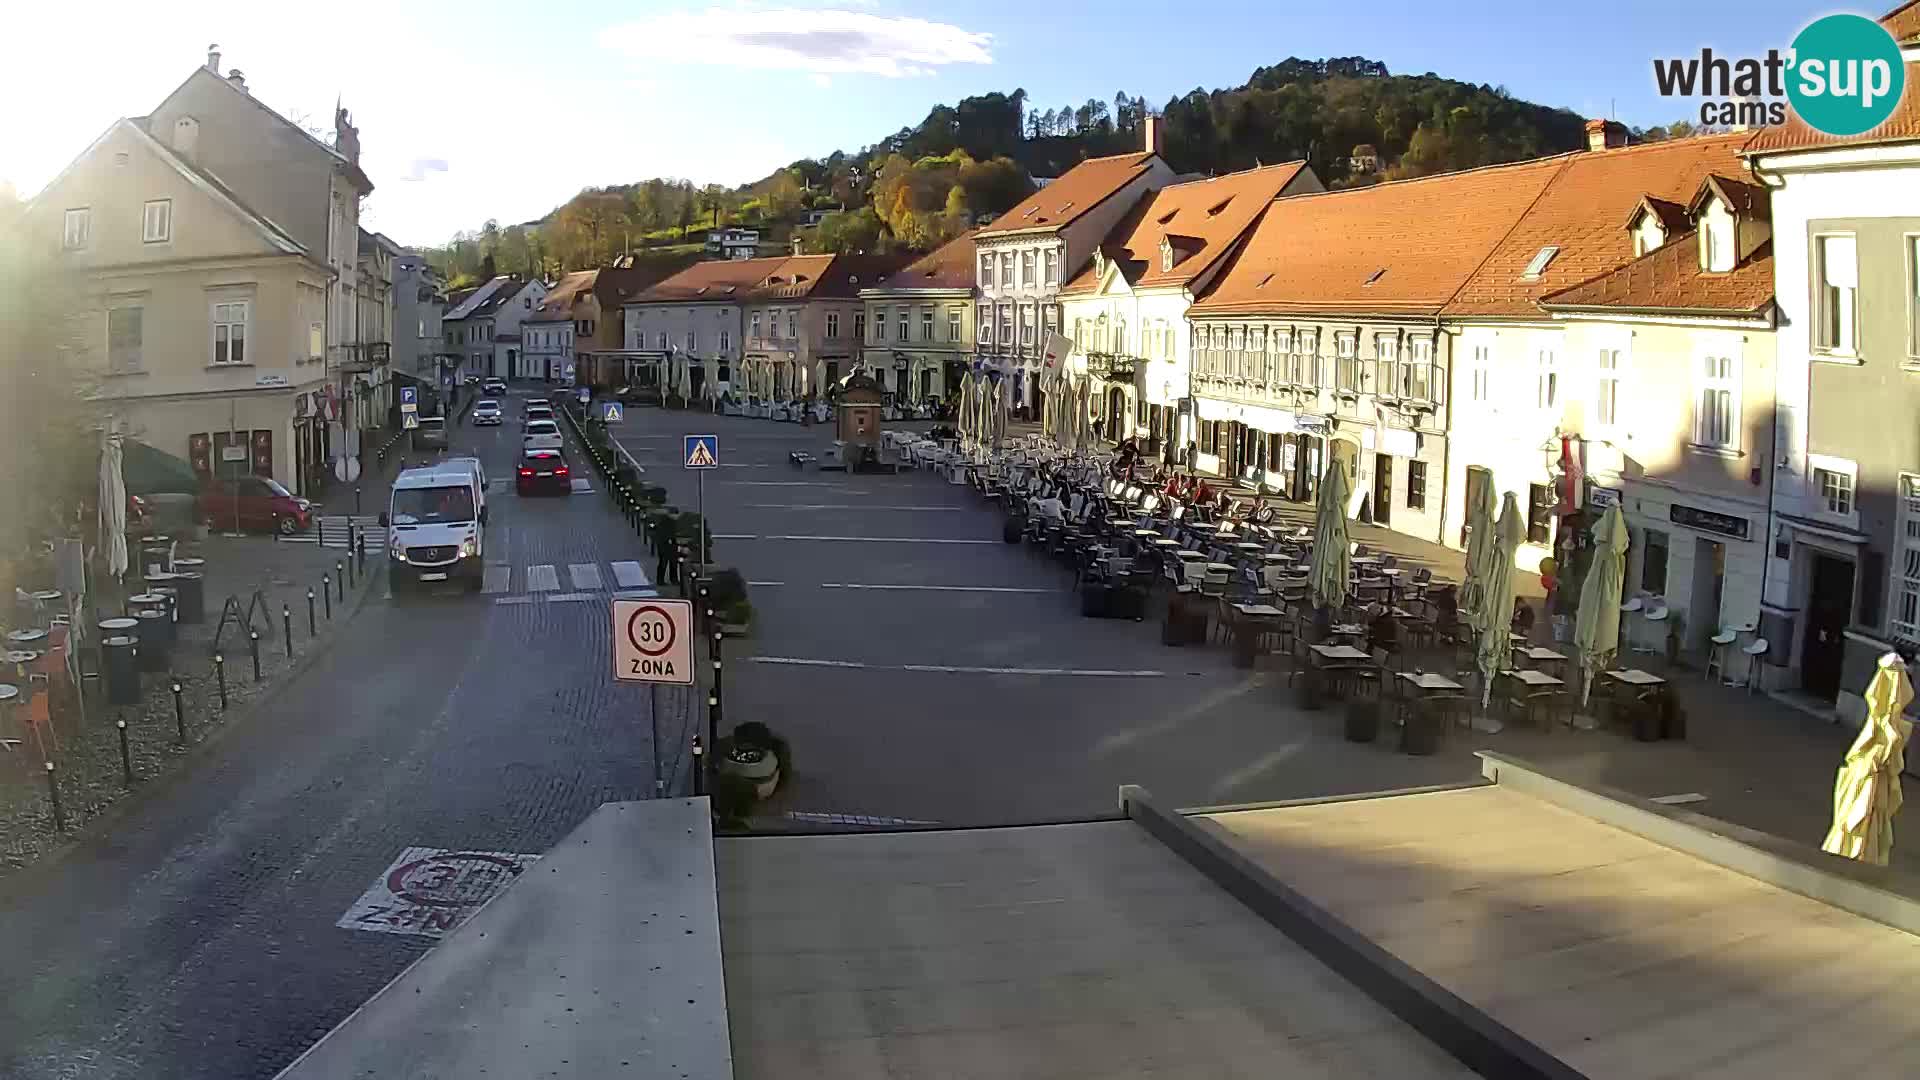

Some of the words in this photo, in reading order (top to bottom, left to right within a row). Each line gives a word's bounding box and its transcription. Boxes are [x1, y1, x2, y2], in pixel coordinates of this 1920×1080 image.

[404, 390, 413, 402] P
[640, 621, 665, 642] 30
[631, 659, 675, 676] ZONA
